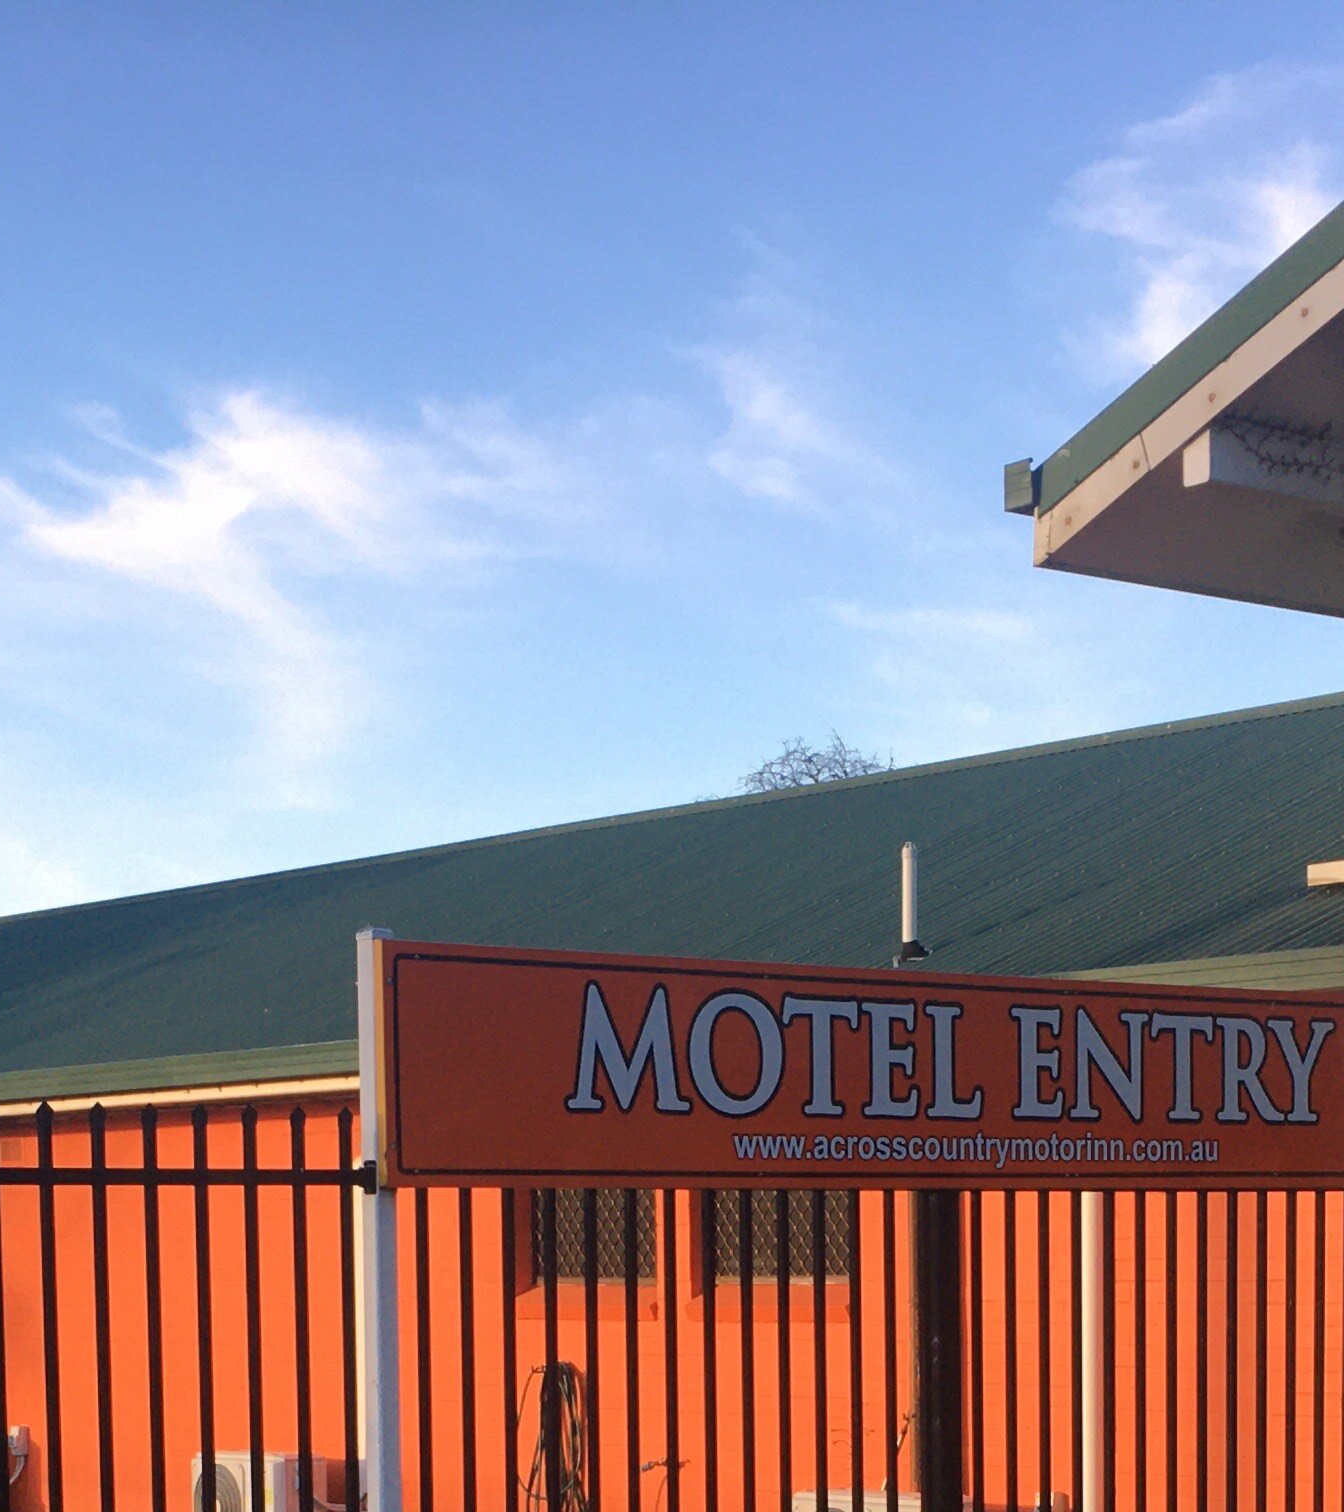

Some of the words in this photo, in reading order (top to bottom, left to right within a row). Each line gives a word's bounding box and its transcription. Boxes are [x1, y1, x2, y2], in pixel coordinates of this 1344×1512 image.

[565, 980, 984, 1121] MOTEL
[1009, 1003, 1337, 1125] ENTRY
[733, 1131, 1219, 1169] www.acrosscountrymotorinn.com.au
